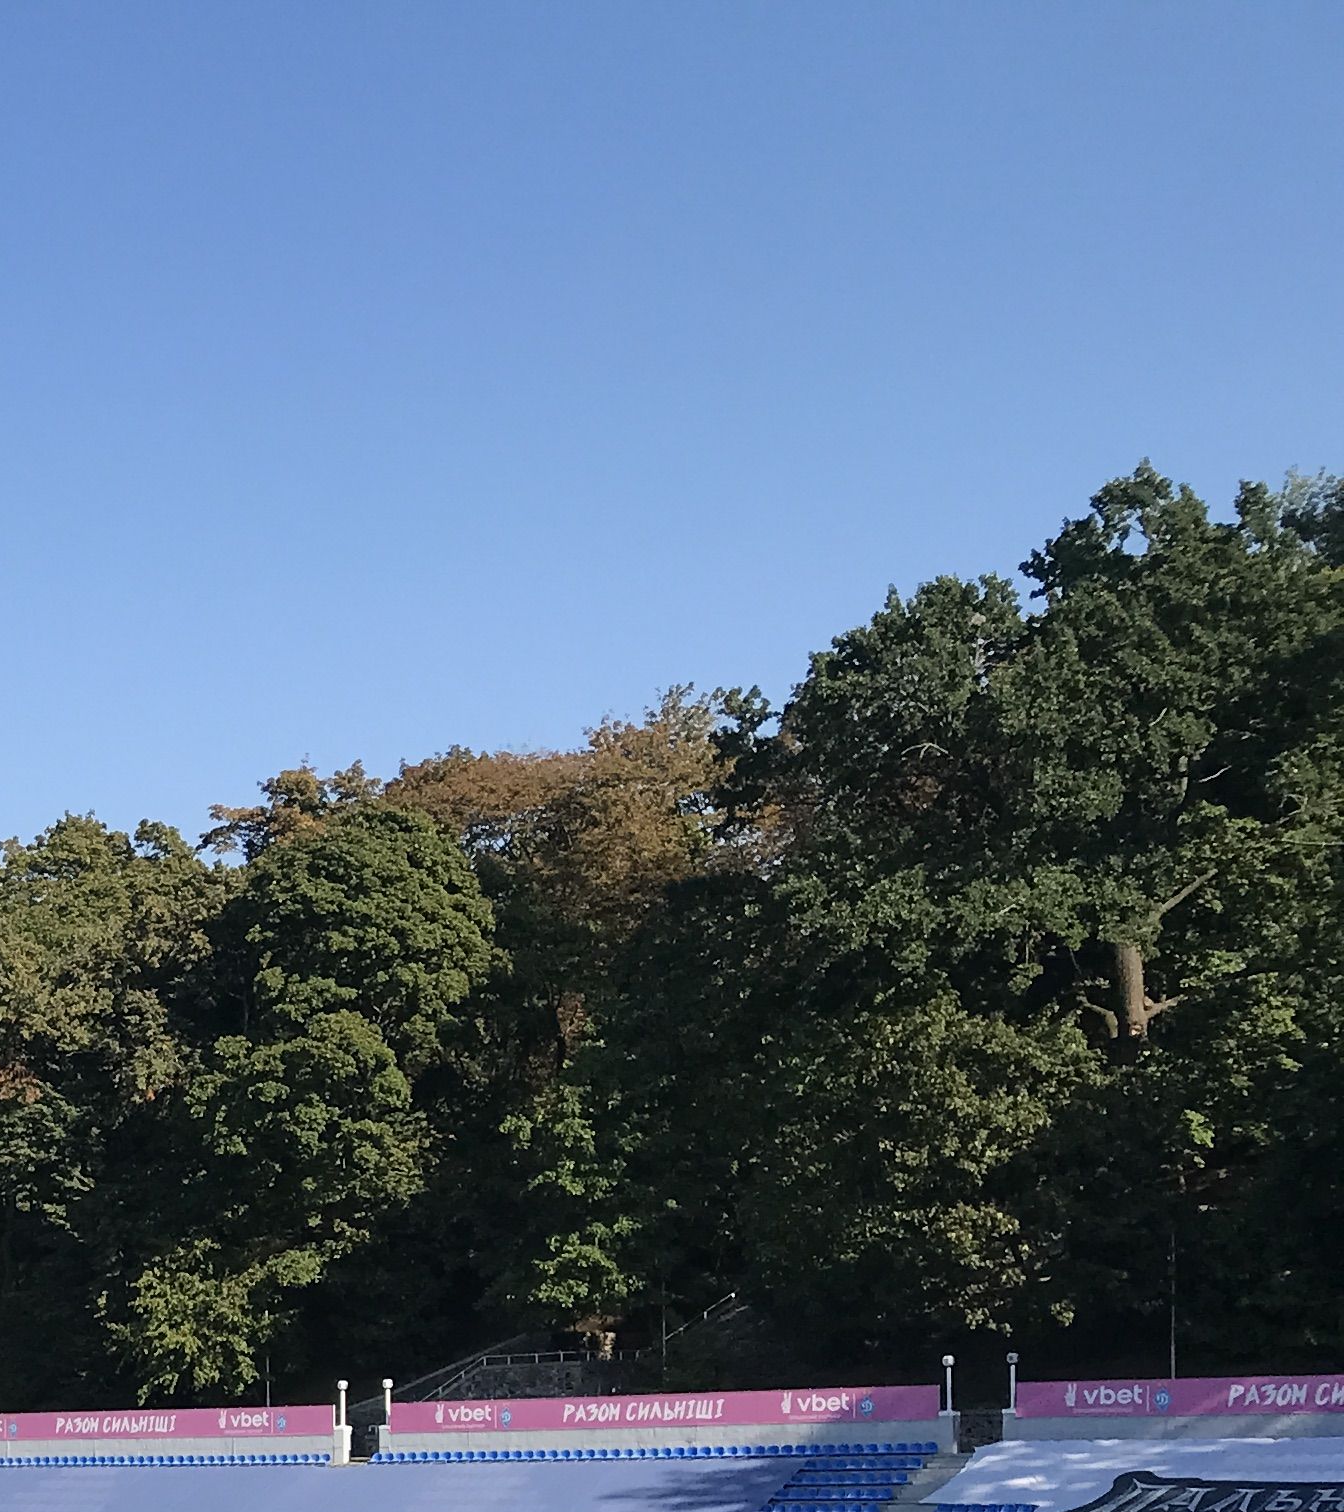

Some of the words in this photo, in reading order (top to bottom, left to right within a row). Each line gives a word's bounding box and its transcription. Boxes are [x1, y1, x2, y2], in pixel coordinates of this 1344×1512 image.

[797, 1393, 850, 1412] vbet
[1083, 1384, 1143, 1405] vbet
[1228, 1384, 1308, 1408] РАЗОМ
[230, 1411, 269, 1428] vbet
[448, 1404, 492, 1422] vbet
[563, 1402, 621, 1423] РАЗОМ
[626, 1399, 725, 1423] СИЛЬНІШІ
[55, 1416, 99, 1434] РАЗОМ
[107, 1414, 177, 1434] СИЛЬНІШІ
